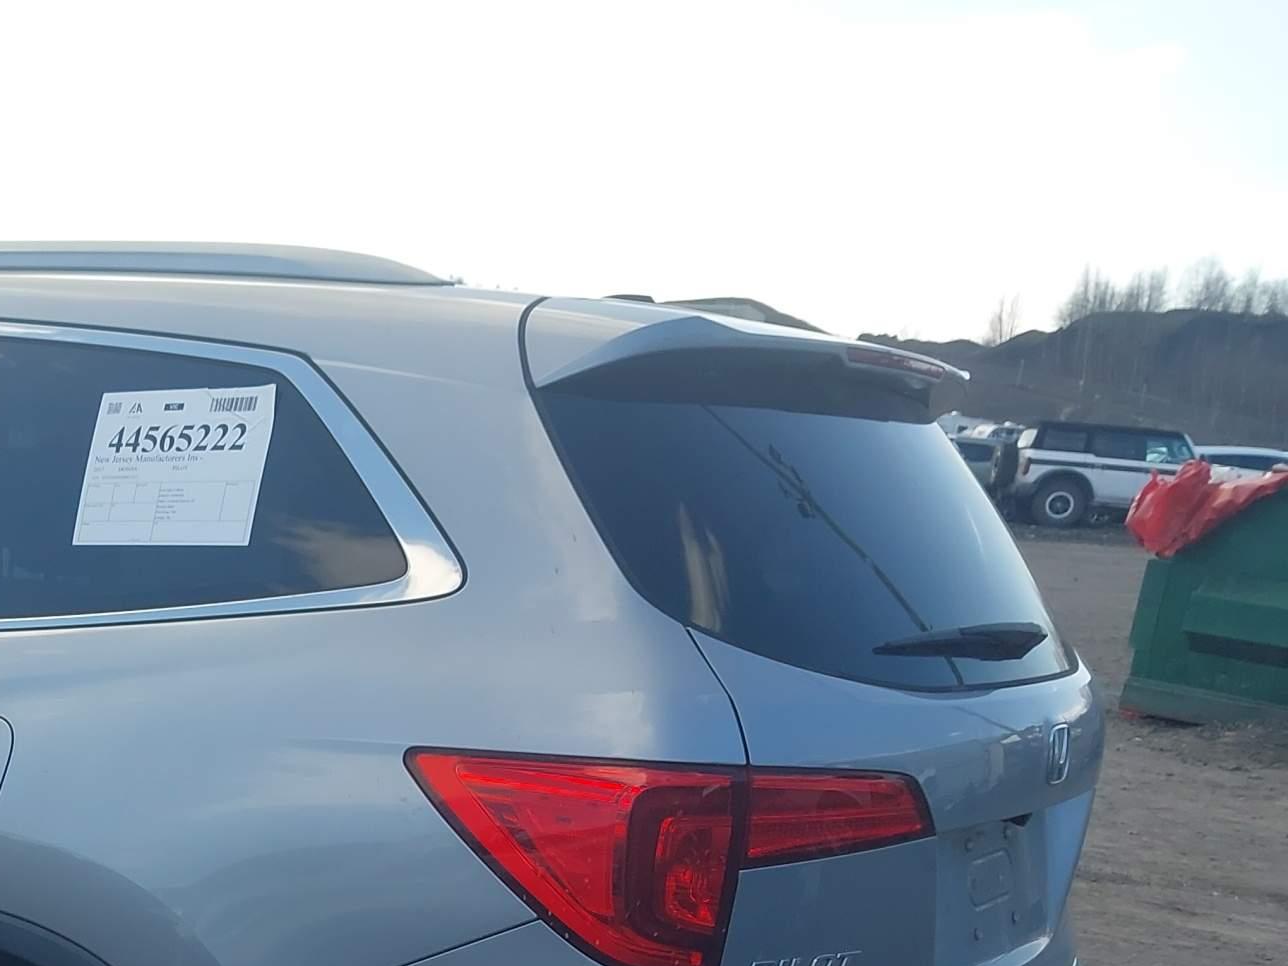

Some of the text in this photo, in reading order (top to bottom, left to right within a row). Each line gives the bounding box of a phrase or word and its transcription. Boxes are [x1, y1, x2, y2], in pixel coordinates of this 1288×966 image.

[108, 423, 247, 453] 44565222
[95, 455, 110, 464] New
[112, 455, 133, 465] Jersey
[136, 454, 185, 463] Manufacturers
